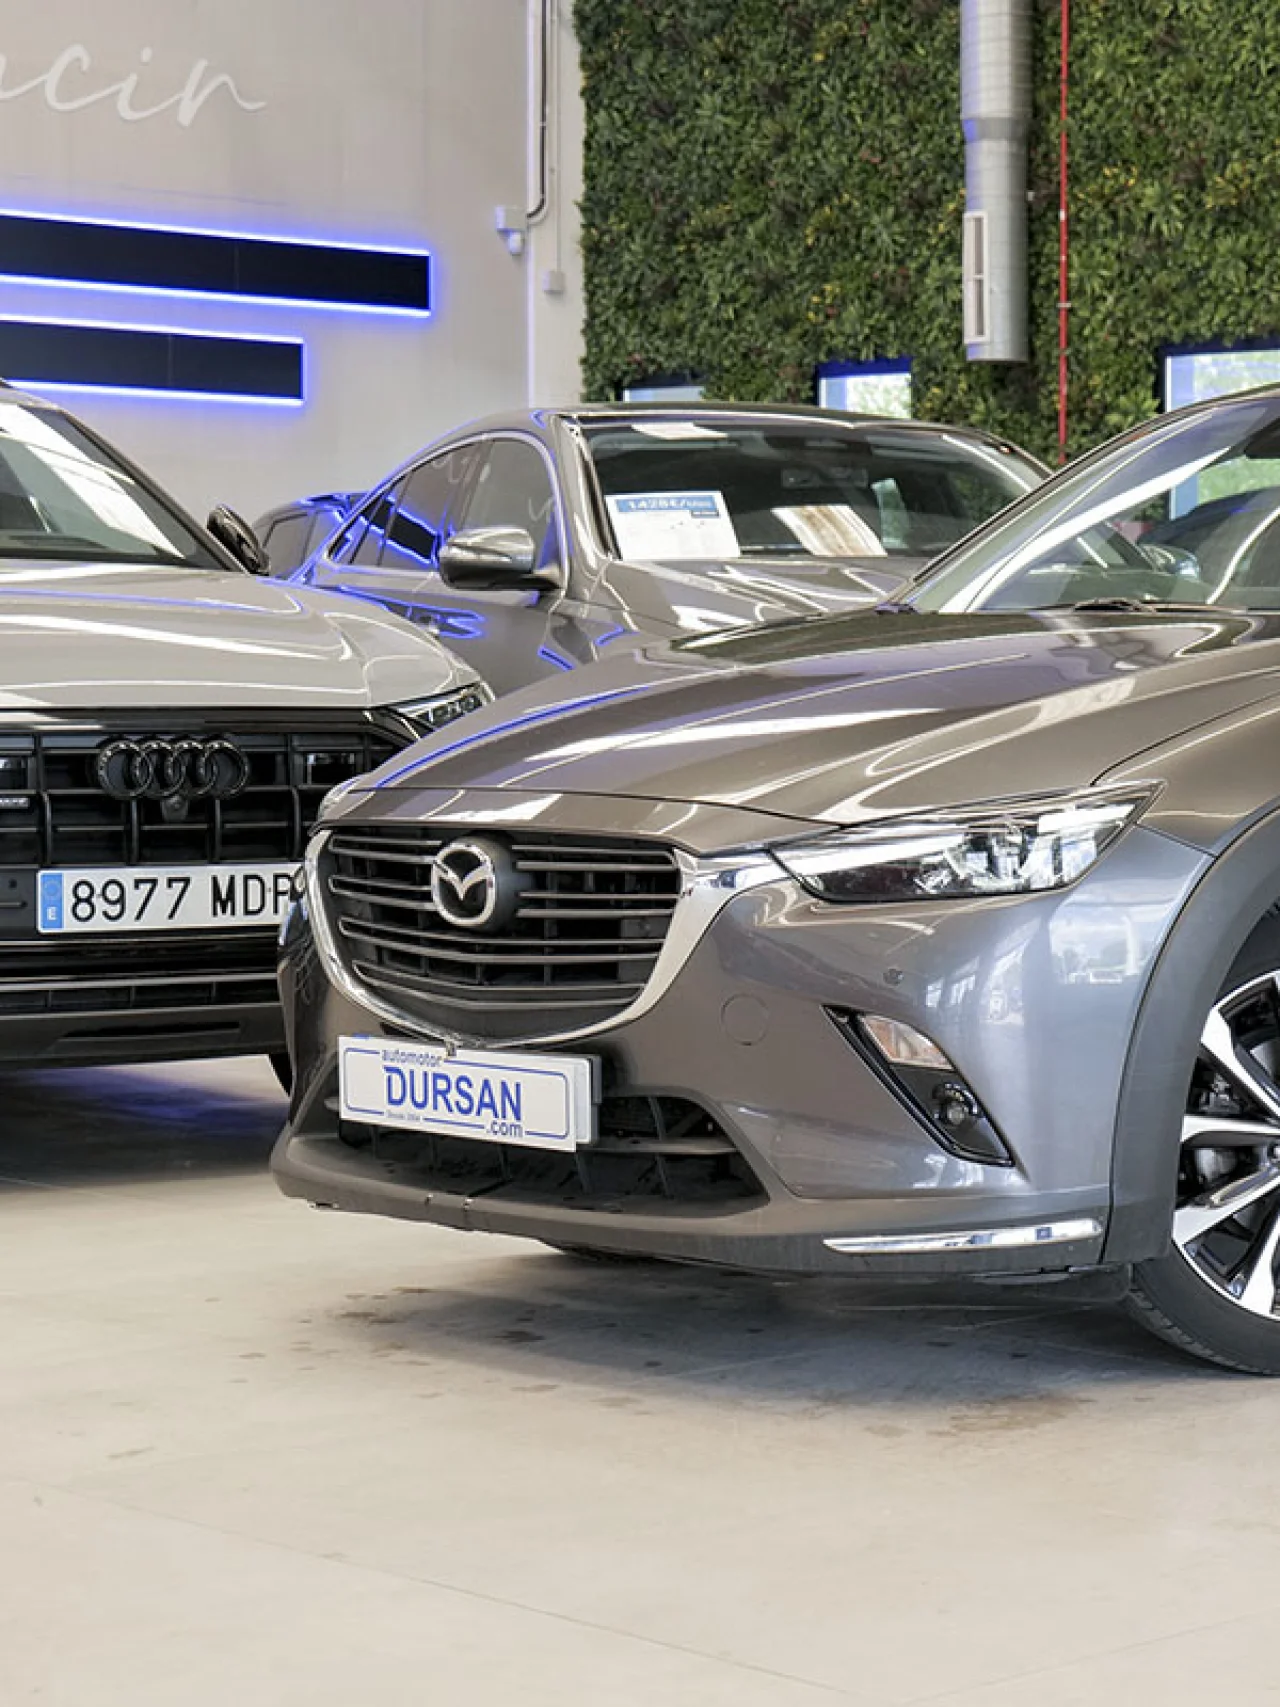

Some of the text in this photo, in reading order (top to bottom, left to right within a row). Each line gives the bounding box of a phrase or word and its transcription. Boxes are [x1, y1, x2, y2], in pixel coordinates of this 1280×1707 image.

[46, 907, 57, 921] E
[71, 877, 191, 923] 8977
[384, 1064, 522, 1121] DURSAN
[486, 1119, 524, 1138] .com
